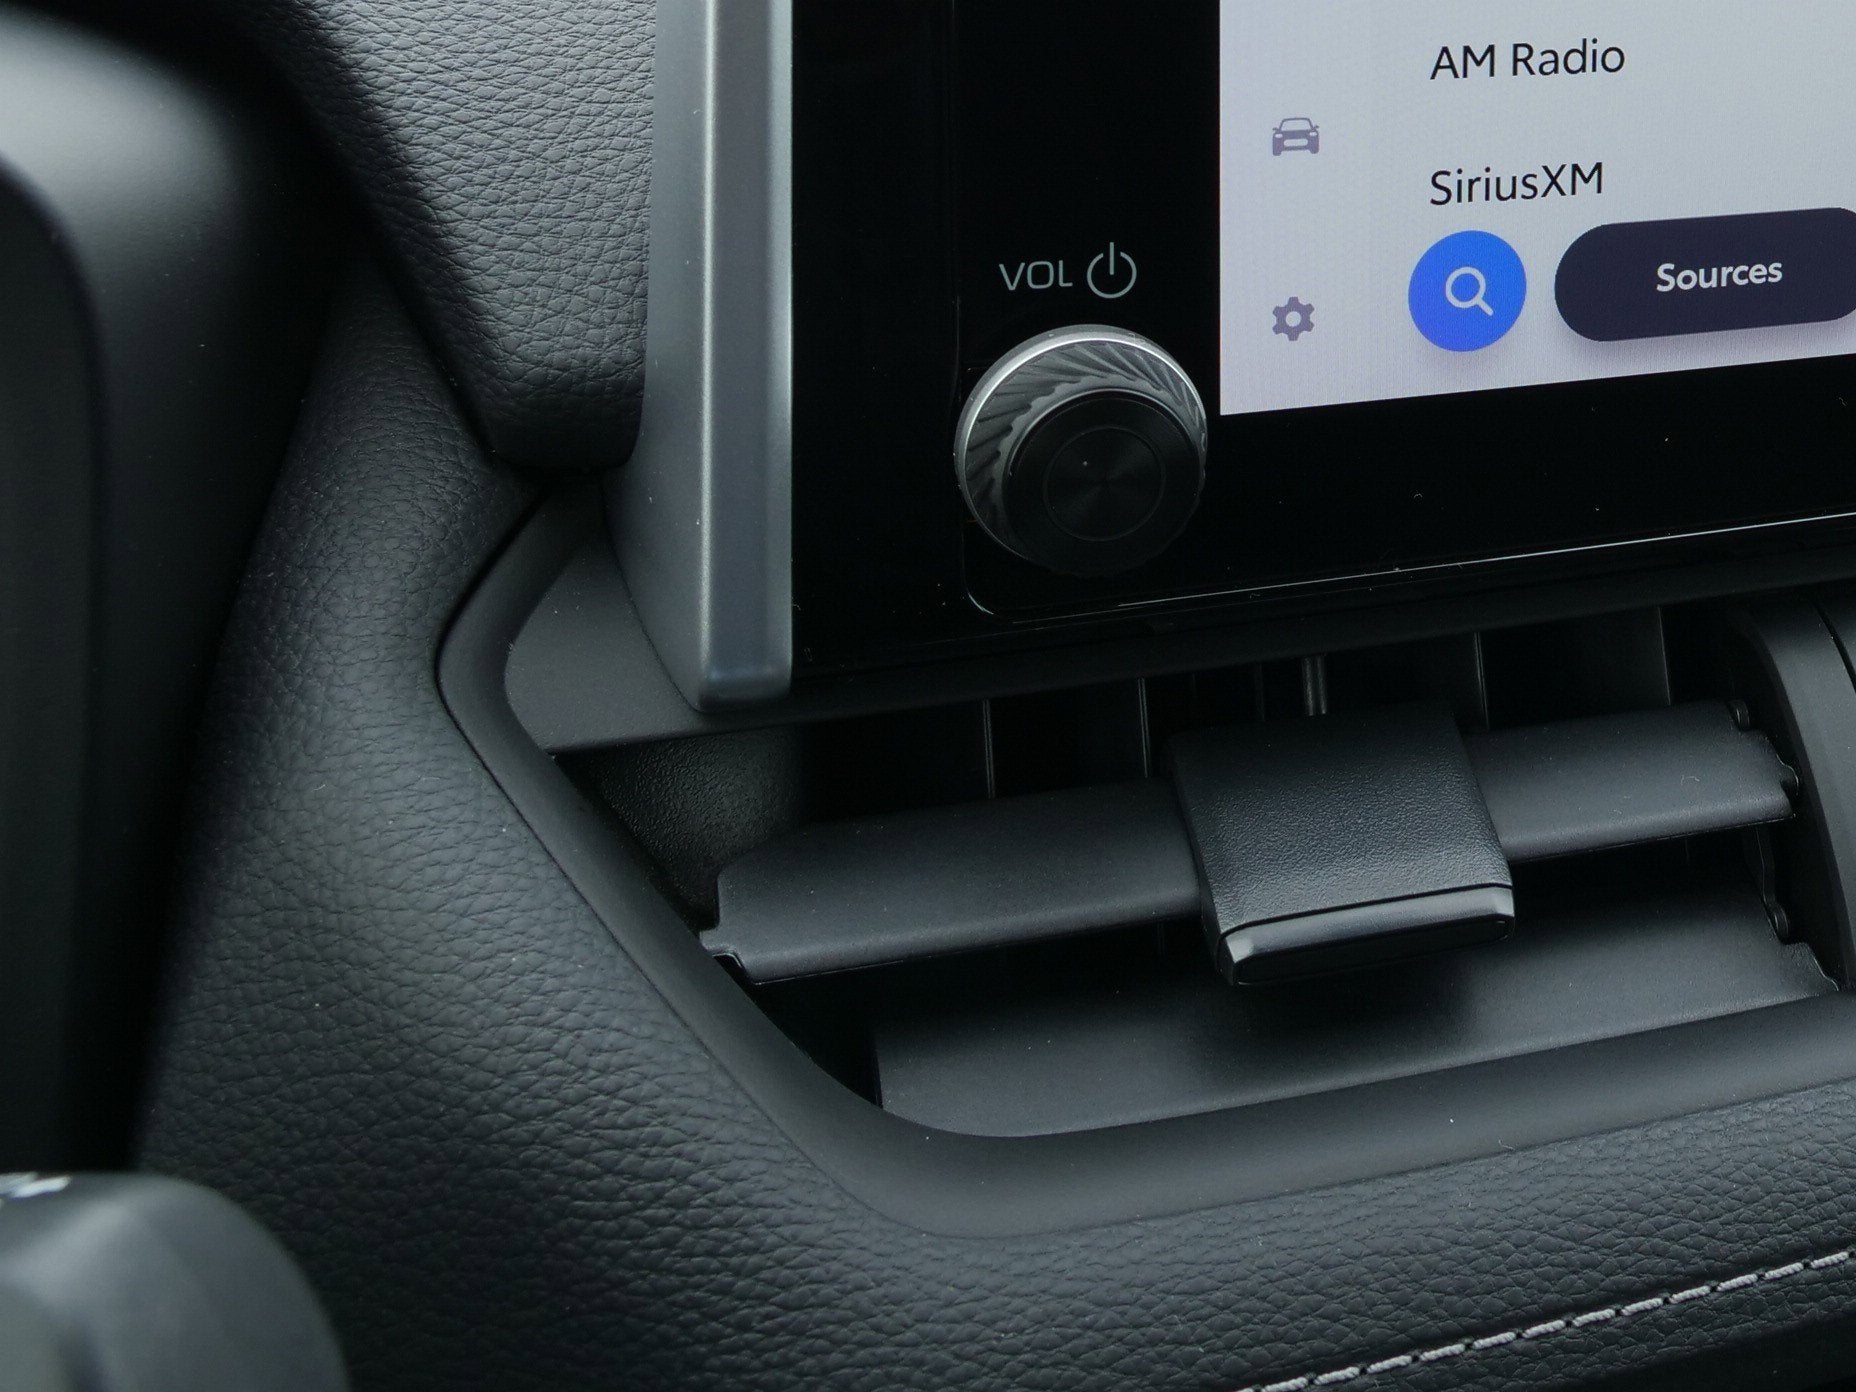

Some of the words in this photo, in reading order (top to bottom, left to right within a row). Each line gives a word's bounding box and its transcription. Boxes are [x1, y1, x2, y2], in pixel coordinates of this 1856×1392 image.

[1429, 44, 1496, 80] AM
[1512, 37, 1626, 77] Radio
[1429, 161, 1603, 206] SiriusXM
[998, 259, 1074, 291] VOL
[1656, 262, 1783, 293] Sources
